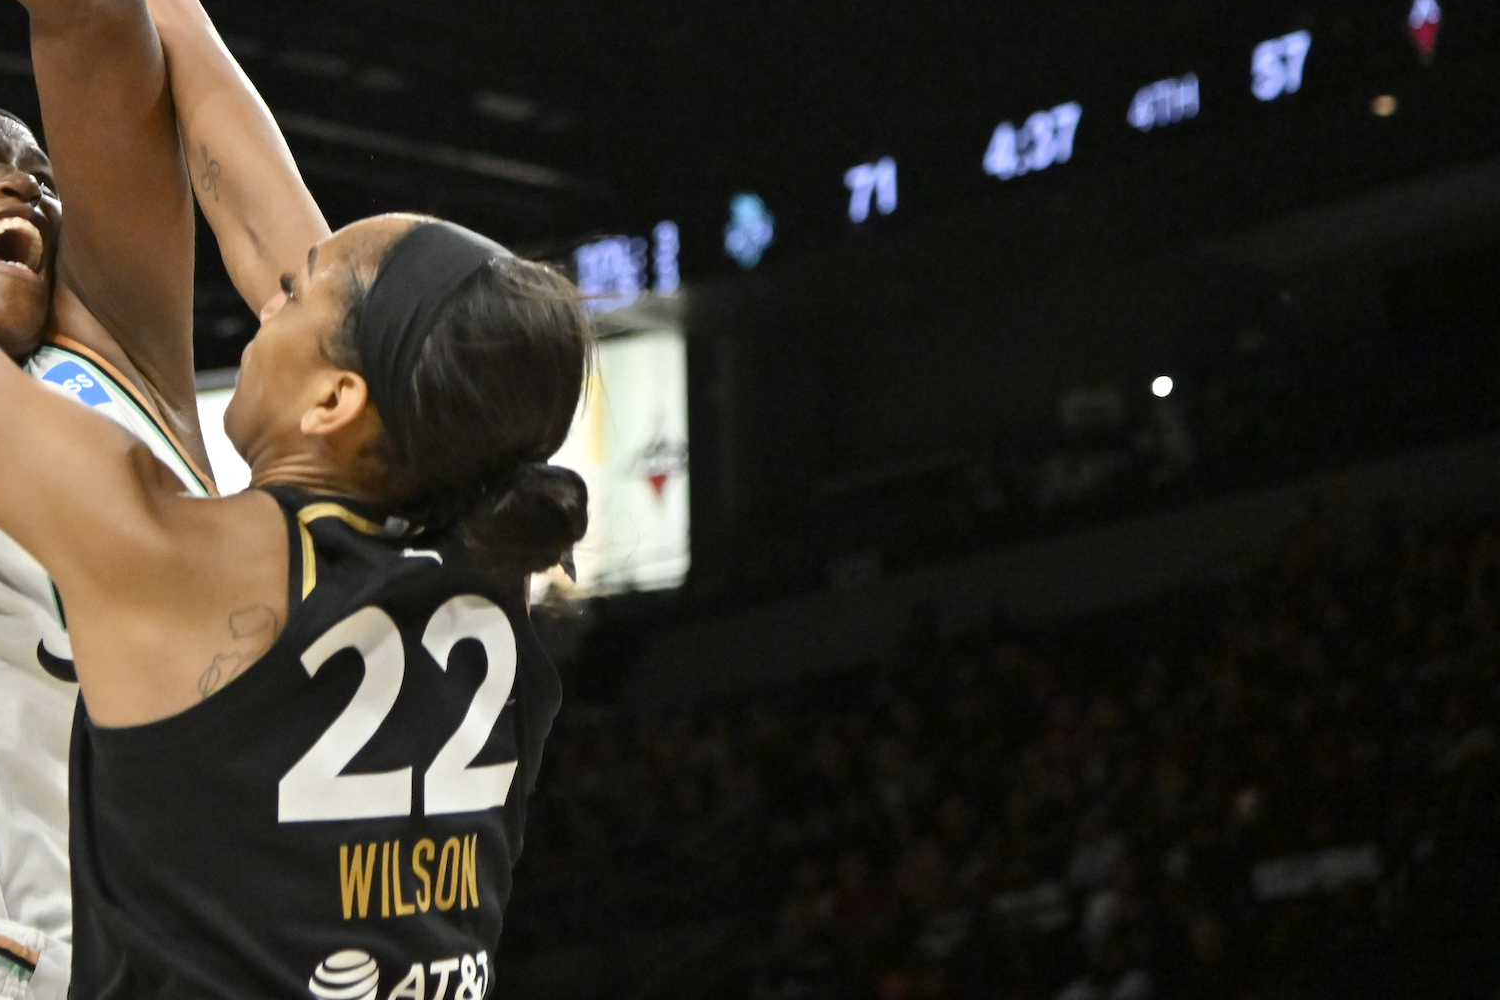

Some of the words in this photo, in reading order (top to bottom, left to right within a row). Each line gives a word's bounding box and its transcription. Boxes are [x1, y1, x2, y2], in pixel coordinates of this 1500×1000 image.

[844, 156, 897, 224] 71
[278, 594, 518, 823] 22
[339, 834, 480, 920] WILSON
